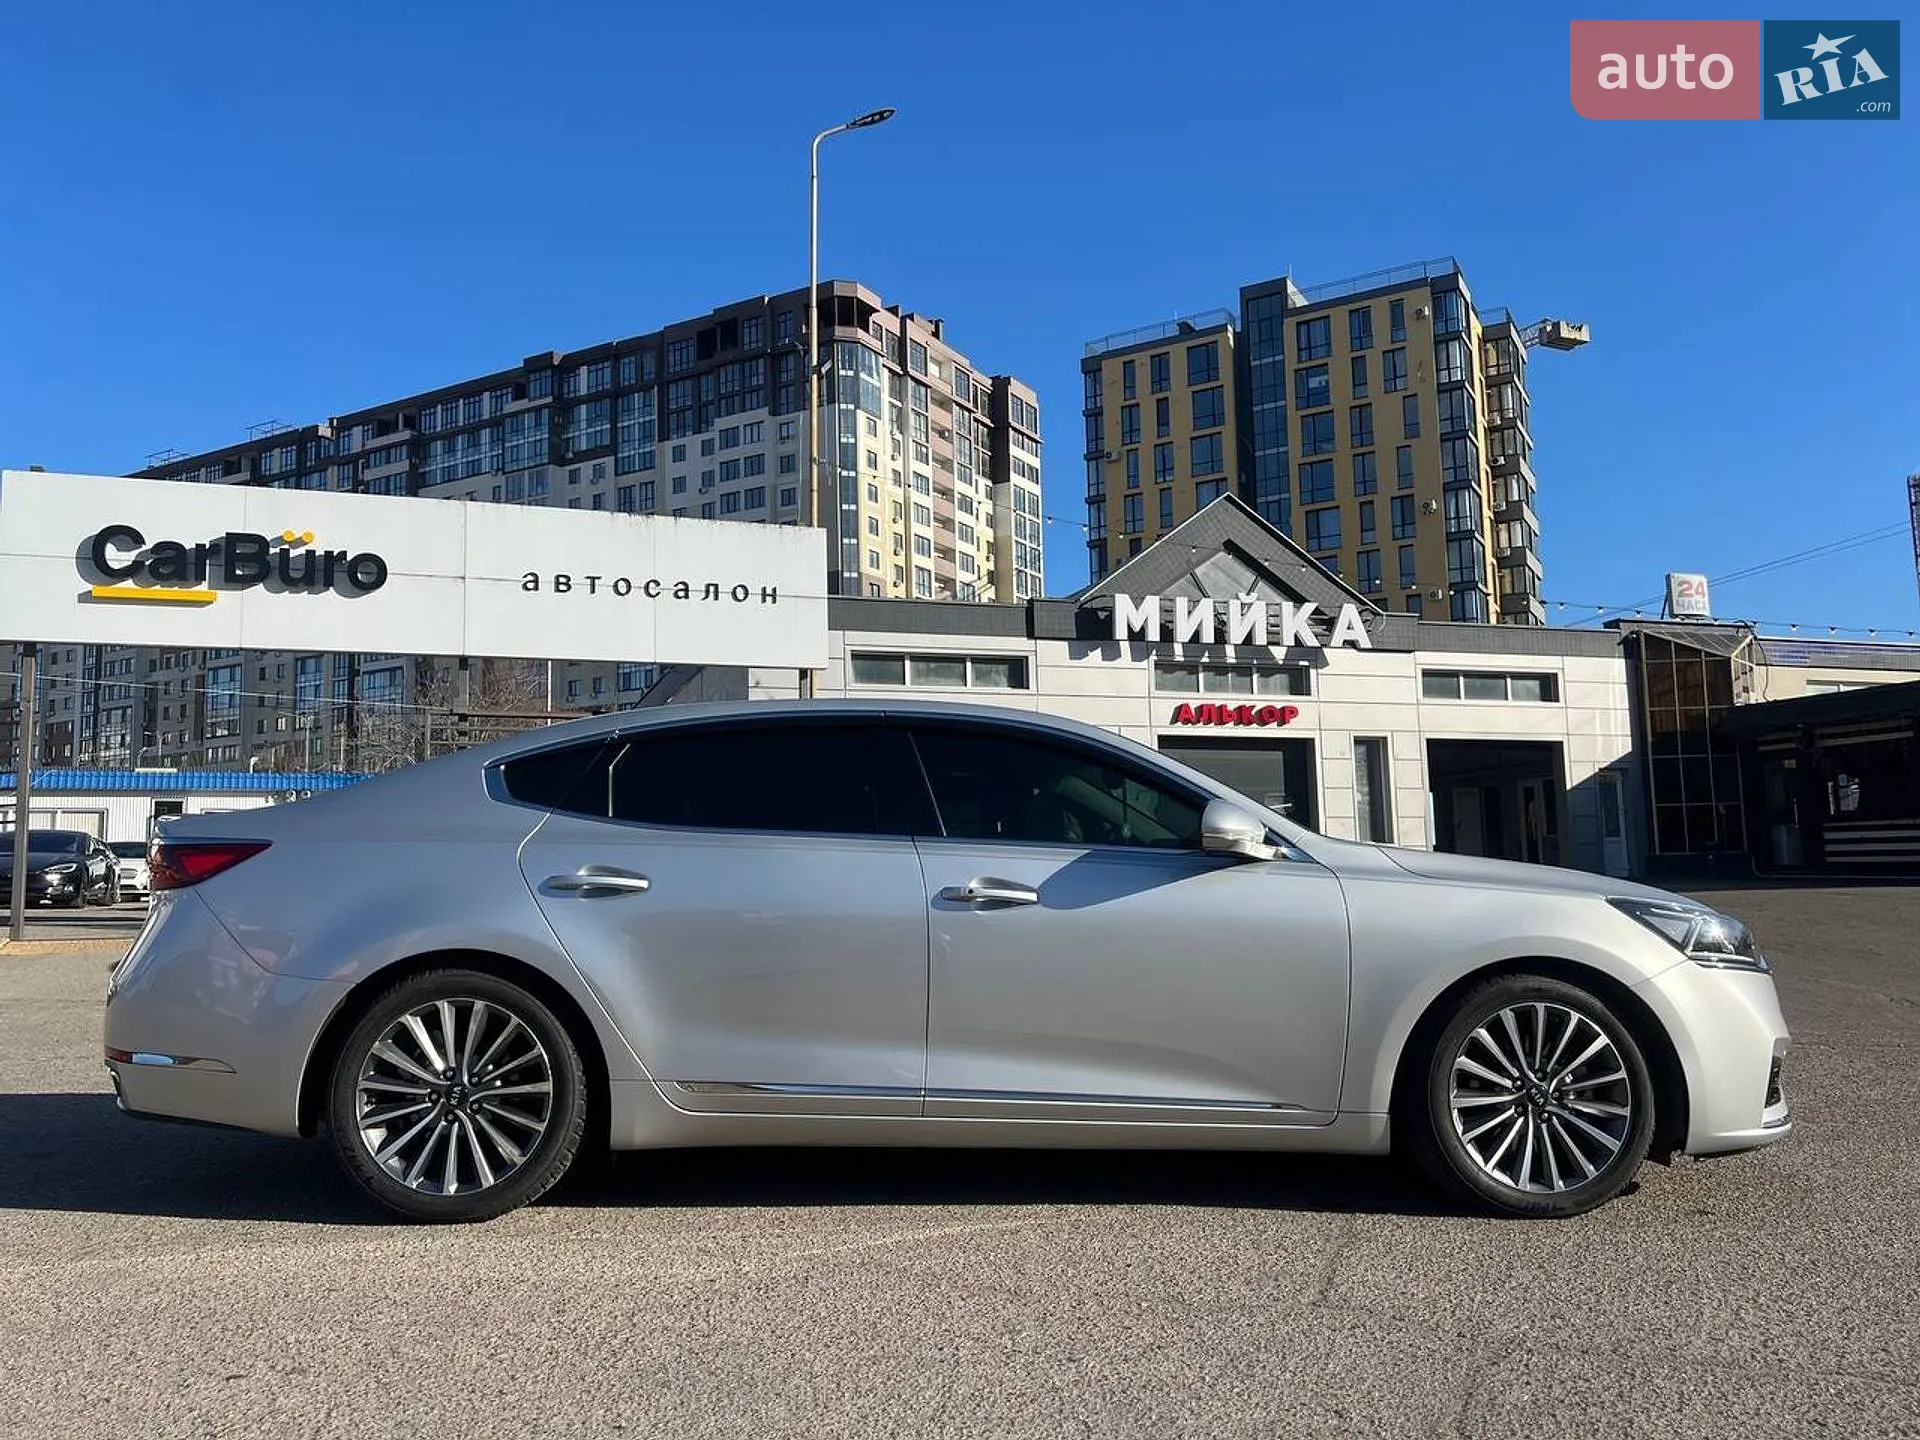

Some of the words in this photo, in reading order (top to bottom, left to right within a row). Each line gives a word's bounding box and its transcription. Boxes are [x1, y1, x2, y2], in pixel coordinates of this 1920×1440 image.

[92, 523, 388, 592] CarBüro
[521, 571, 778, 605] автосалон
[1677, 580, 1706, 598] 24
[1113, 592, 1373, 649] МИЙКА
[1173, 703, 1299, 726] АЛЬКОР
